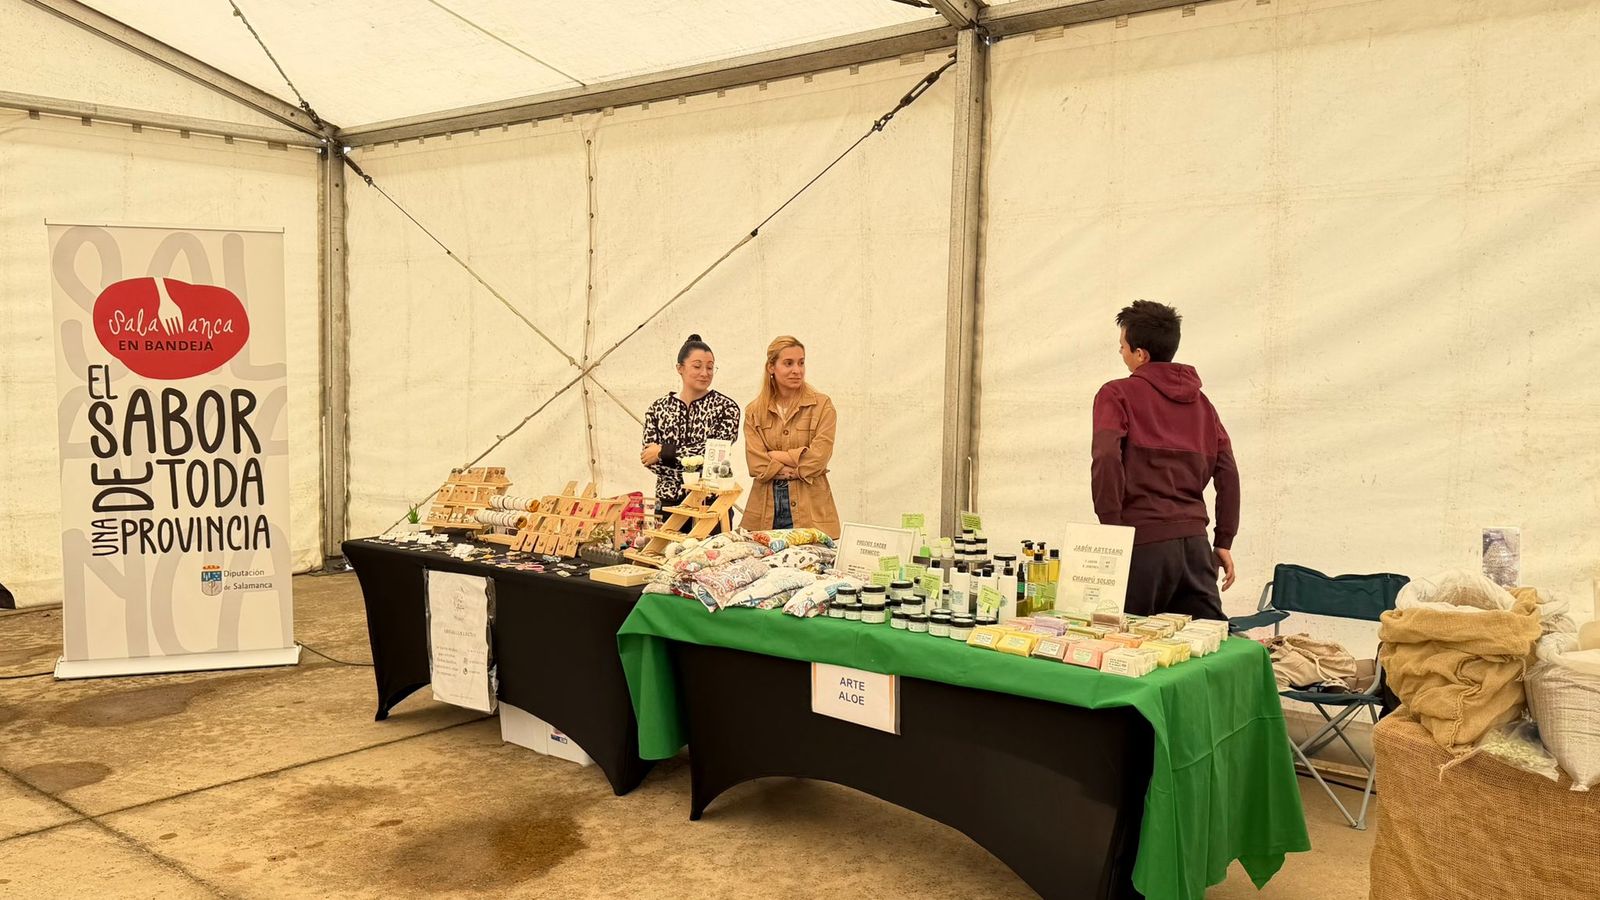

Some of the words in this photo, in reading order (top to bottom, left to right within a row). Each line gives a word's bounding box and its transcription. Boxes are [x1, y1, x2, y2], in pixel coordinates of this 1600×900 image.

[119, 340, 139, 351] EN
[145, 340, 214, 352] BANDEJA
[88, 364, 119, 400] EL
[88, 387, 262, 459] SABOR
[91, 461, 155, 513] DE
[156, 457, 265, 509] TODA
[92, 518, 119, 556] UNA
[121, 514, 271, 555] PROVINCIA
[233, 582, 272, 590] Salamanca
[838, 690, 865, 706] ALOE
[839, 677, 865, 692] ARTE
